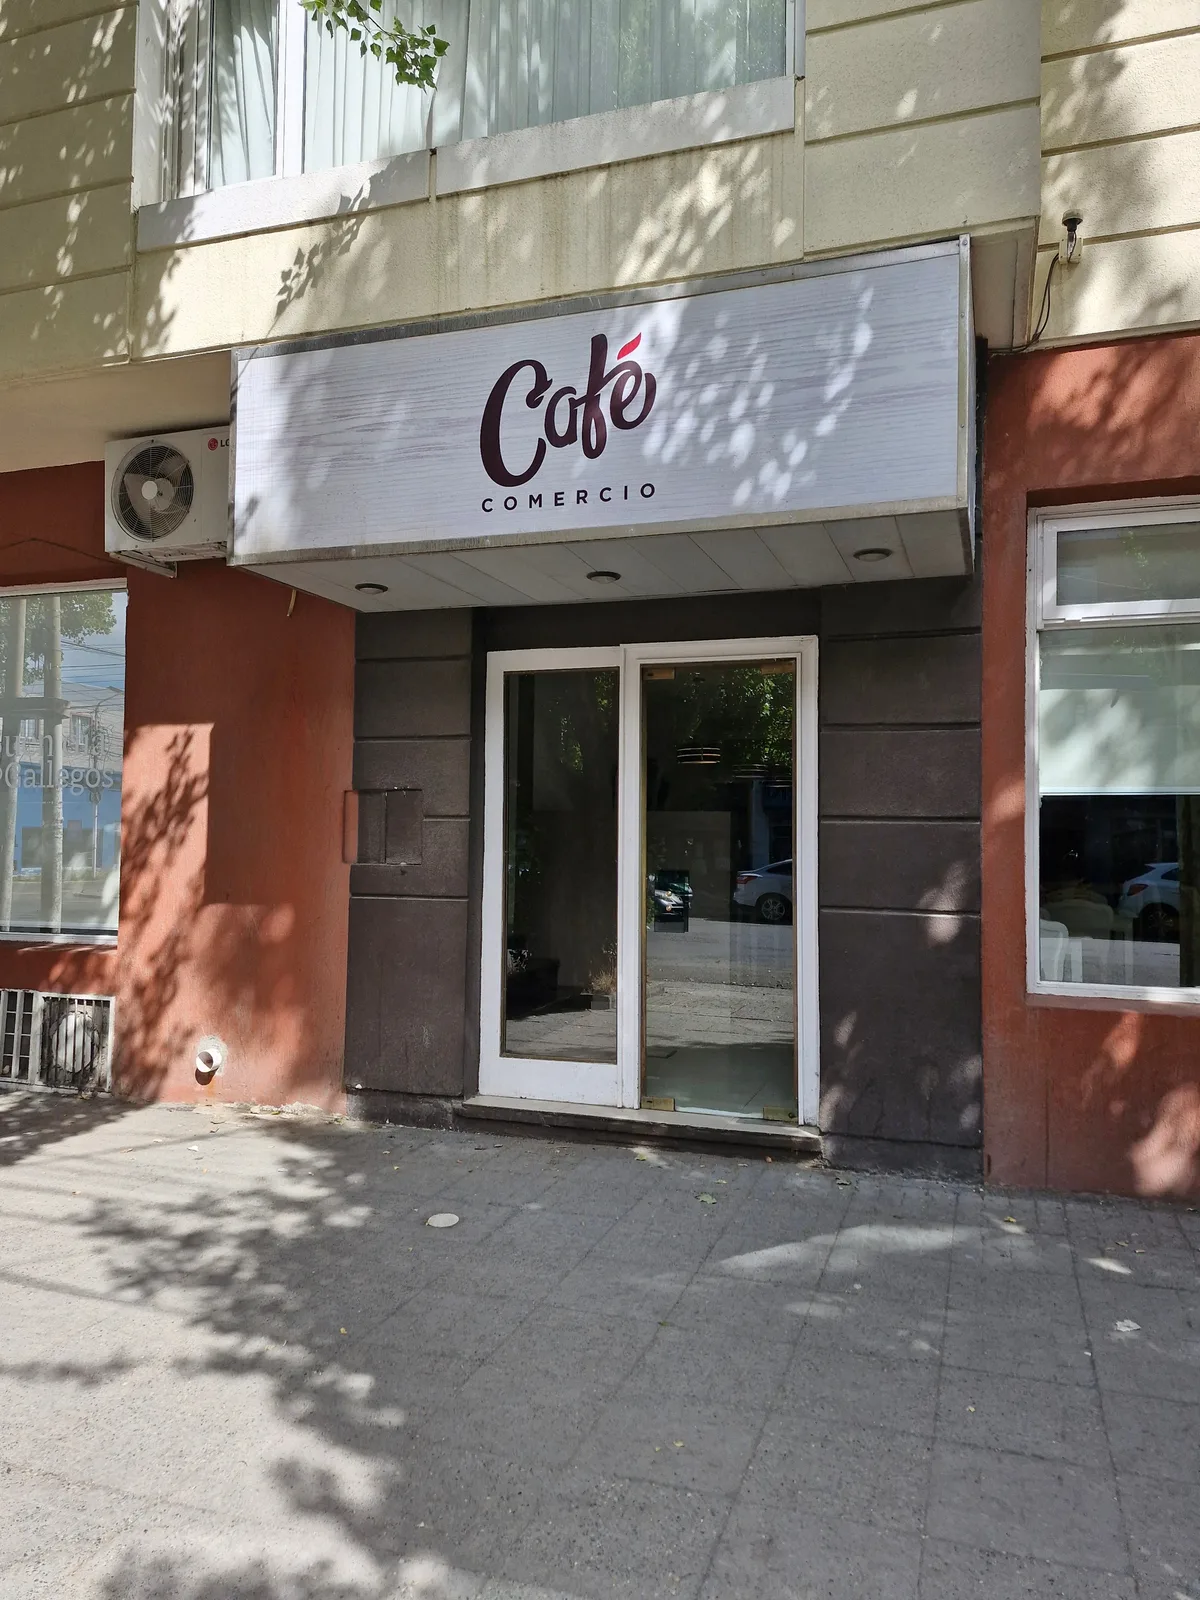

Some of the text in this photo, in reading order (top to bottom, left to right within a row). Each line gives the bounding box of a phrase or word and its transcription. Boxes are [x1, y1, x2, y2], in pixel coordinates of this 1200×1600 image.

[480, 332, 657, 488] Café
[481, 482, 656, 513] COMERCIO
[0, 759, 114, 797] Gallegos
